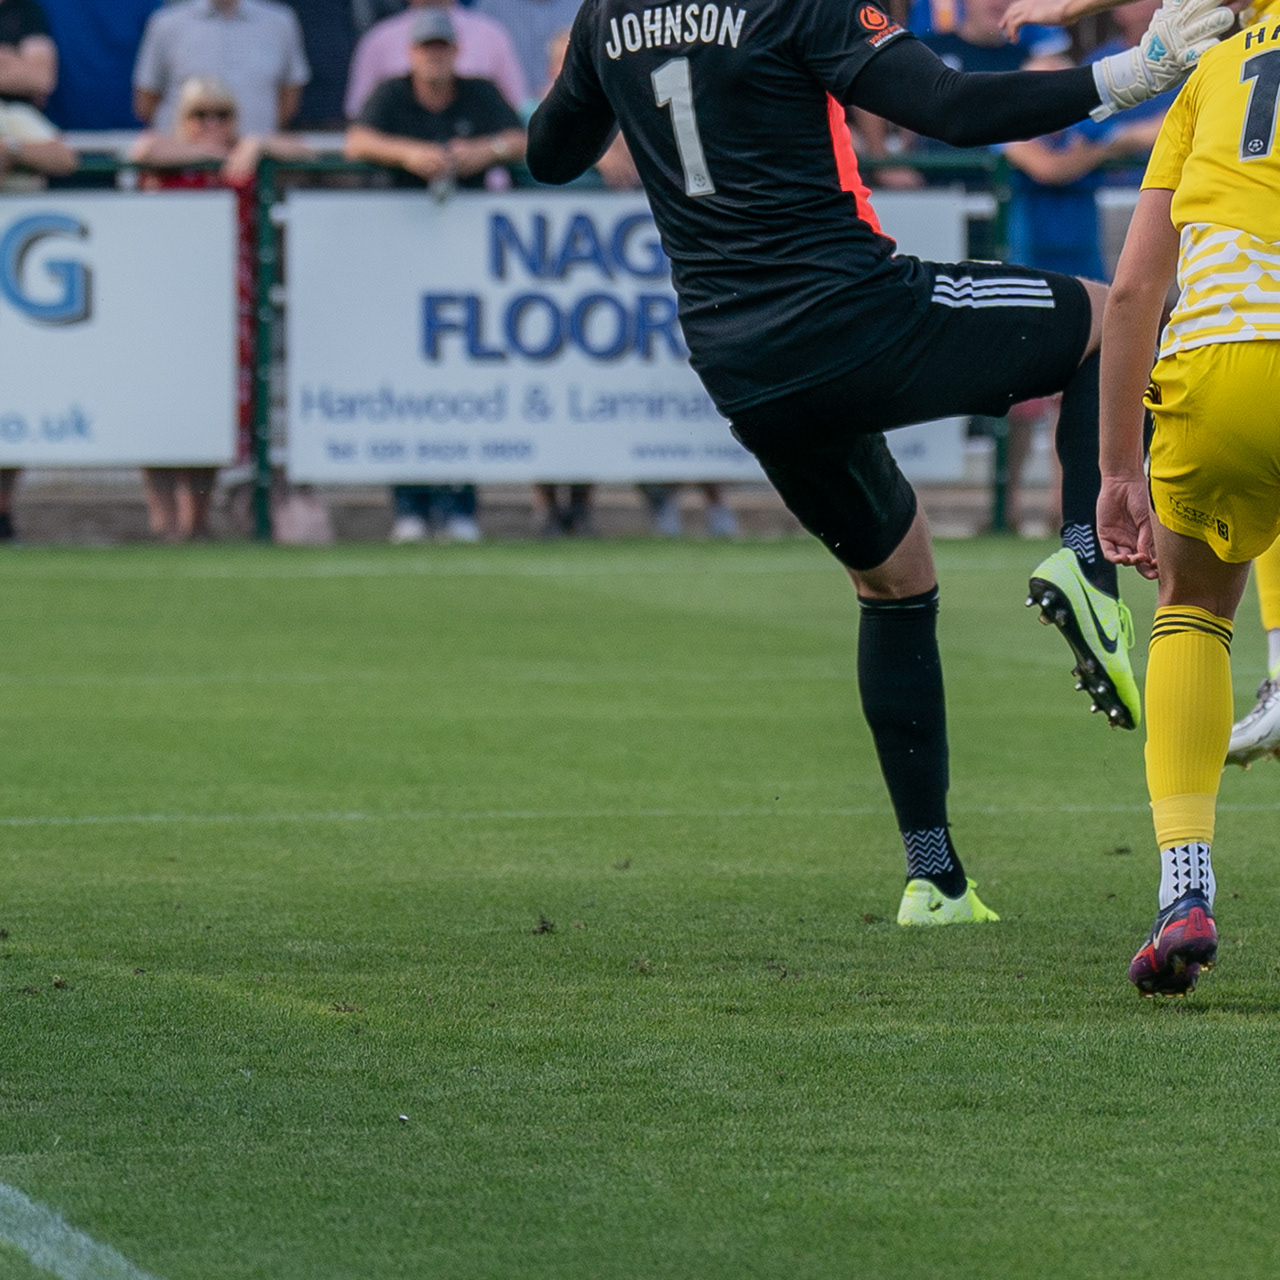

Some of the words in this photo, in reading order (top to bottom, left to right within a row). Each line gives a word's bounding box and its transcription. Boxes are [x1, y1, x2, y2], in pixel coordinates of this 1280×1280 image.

[605, 3, 747, 60] JOHNSON
[650, 56, 716, 198] 1
[488, 213, 671, 280] NAG
[422, 291, 691, 362] FLOOR
[300, 382, 509, 422] Hardwood
[525, 383, 554, 421] &
